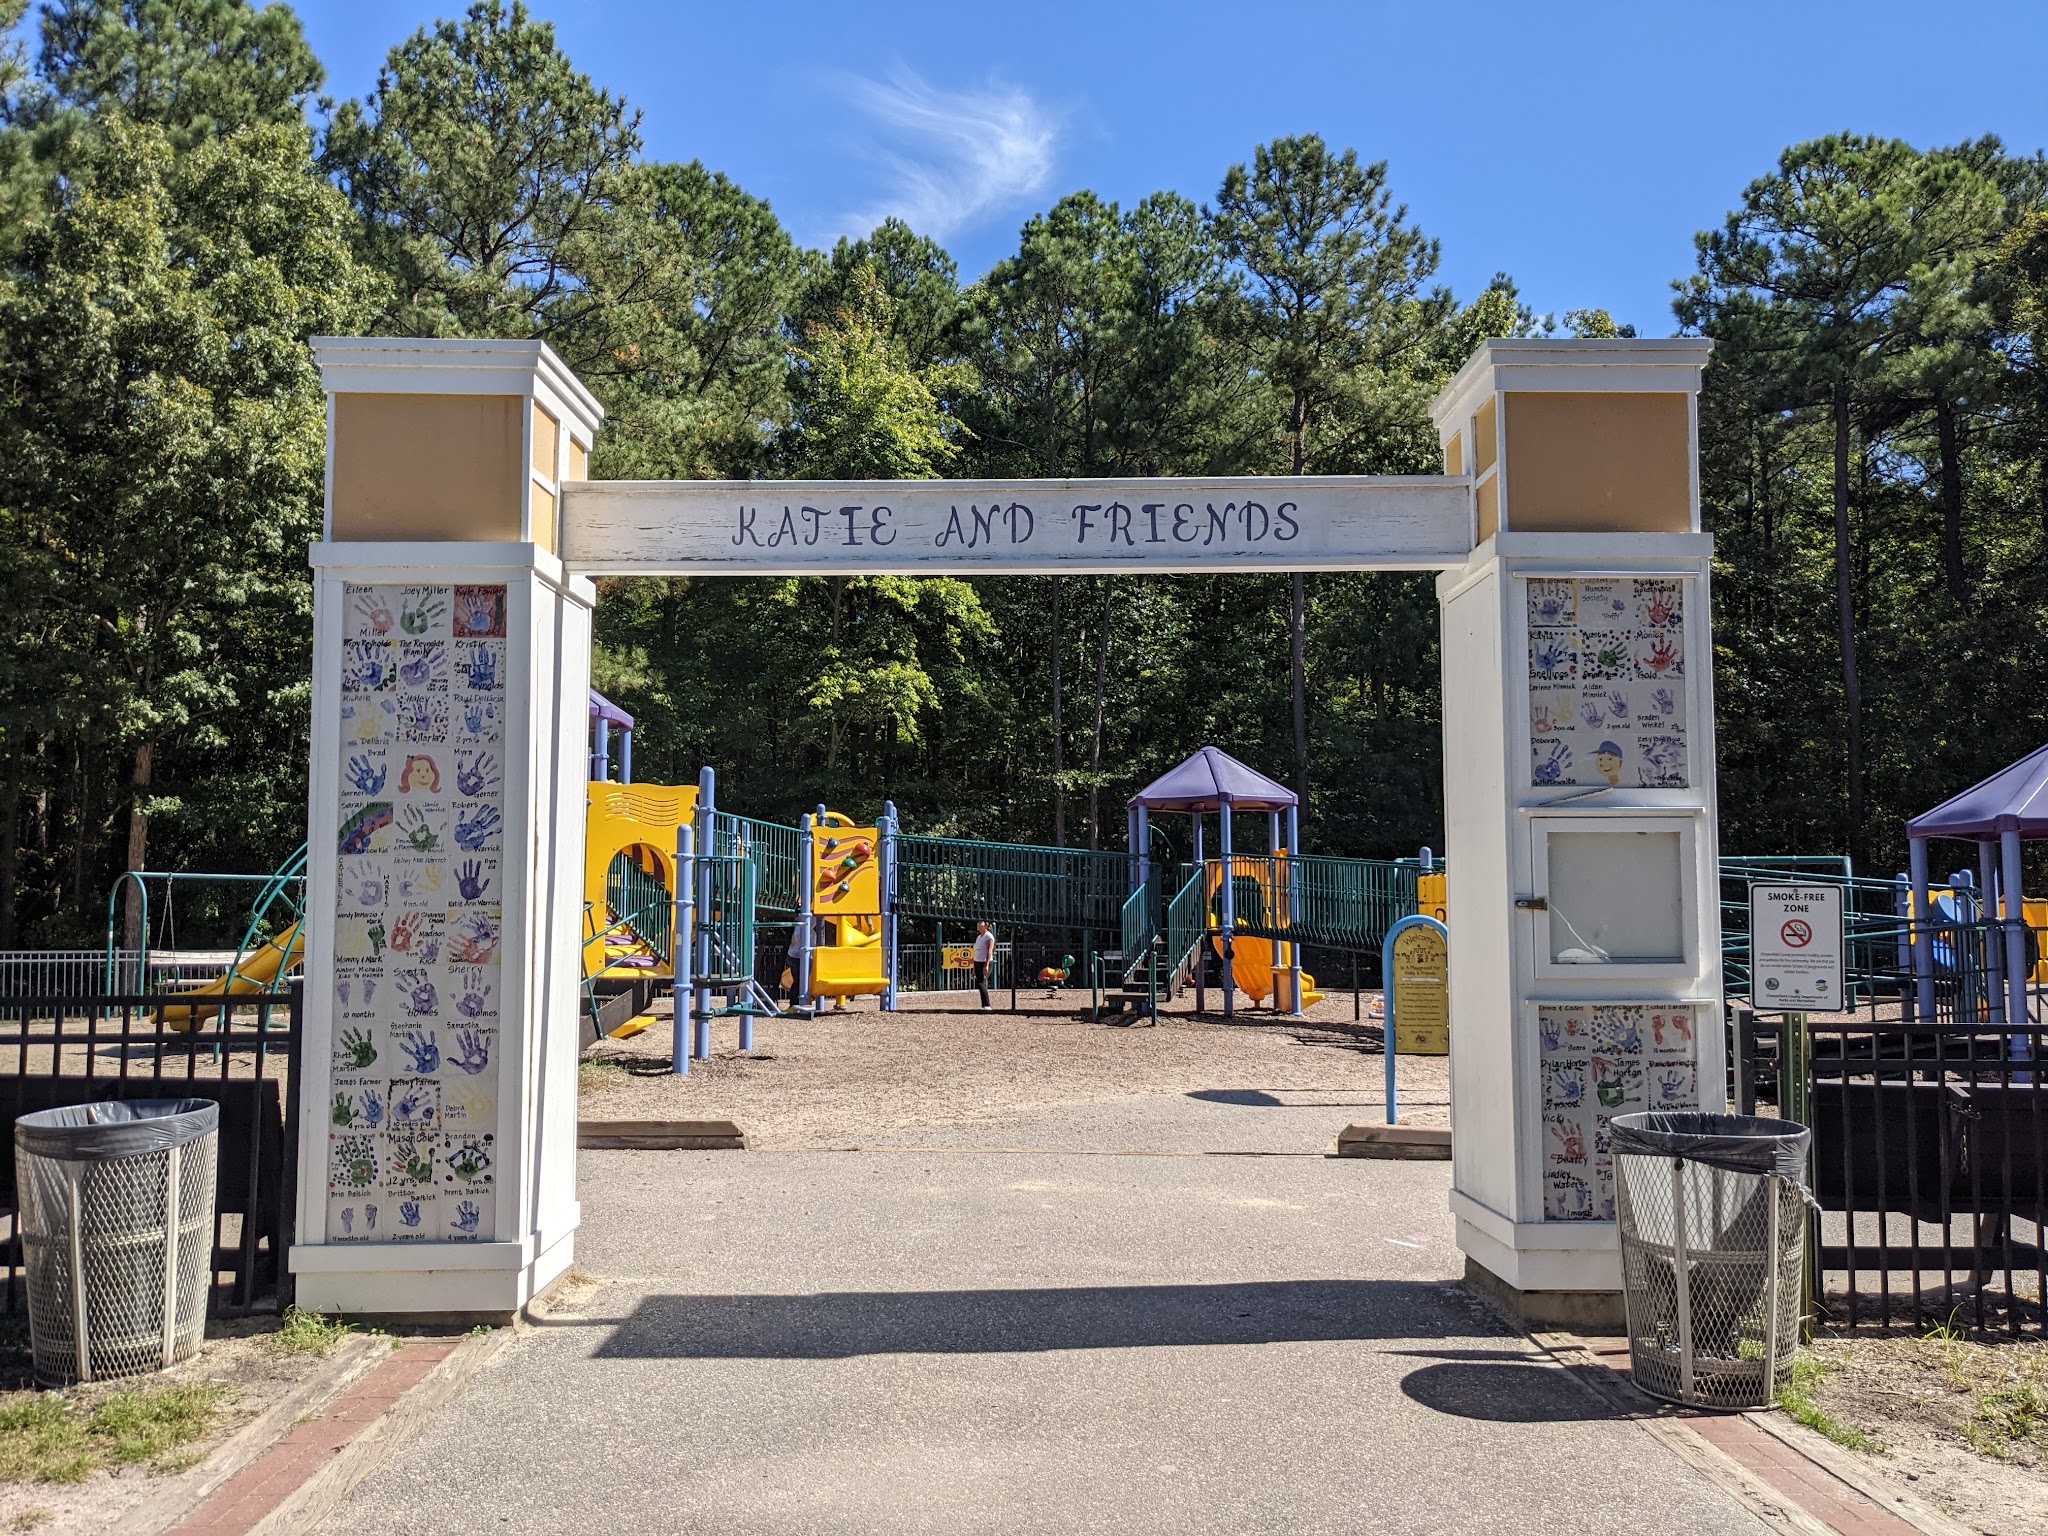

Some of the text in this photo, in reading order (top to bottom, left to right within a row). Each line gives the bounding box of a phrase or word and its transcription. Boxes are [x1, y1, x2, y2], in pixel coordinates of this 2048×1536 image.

[731, 501, 1301, 548] KATIE AND FRIENDS
[345, 586, 373, 594] Eileen
[400, 586, 449, 597] Joey Miller
[1767, 892, 1825, 901] SMOKE-FREE
[1783, 904, 1809, 913] ZONE
[418, 930, 445, 938] Madison
[1403, 933, 1437, 946] Welcome
[419, 957, 437, 965] Rice
[448, 966, 483, 975] Sherry
[351, 1010, 376, 1018] months
[407, 1006, 439, 1017] Holmes
[470, 1006, 498, 1017] Holmes
[390, 1021, 423, 1030] Stephanie
[446, 1021, 479, 1030] Samantha
[1614, 1058, 1640, 1067] James
[332, 1065, 357, 1073] Martin
[388, 1133, 435, 1144] Mason Cole
[444, 1132, 476, 1140] Brandon
[1556, 1154, 1588, 1166] Beatty
[388, 1175, 432, 1185] 12 old
[392, 1233, 397, 1241] 2
